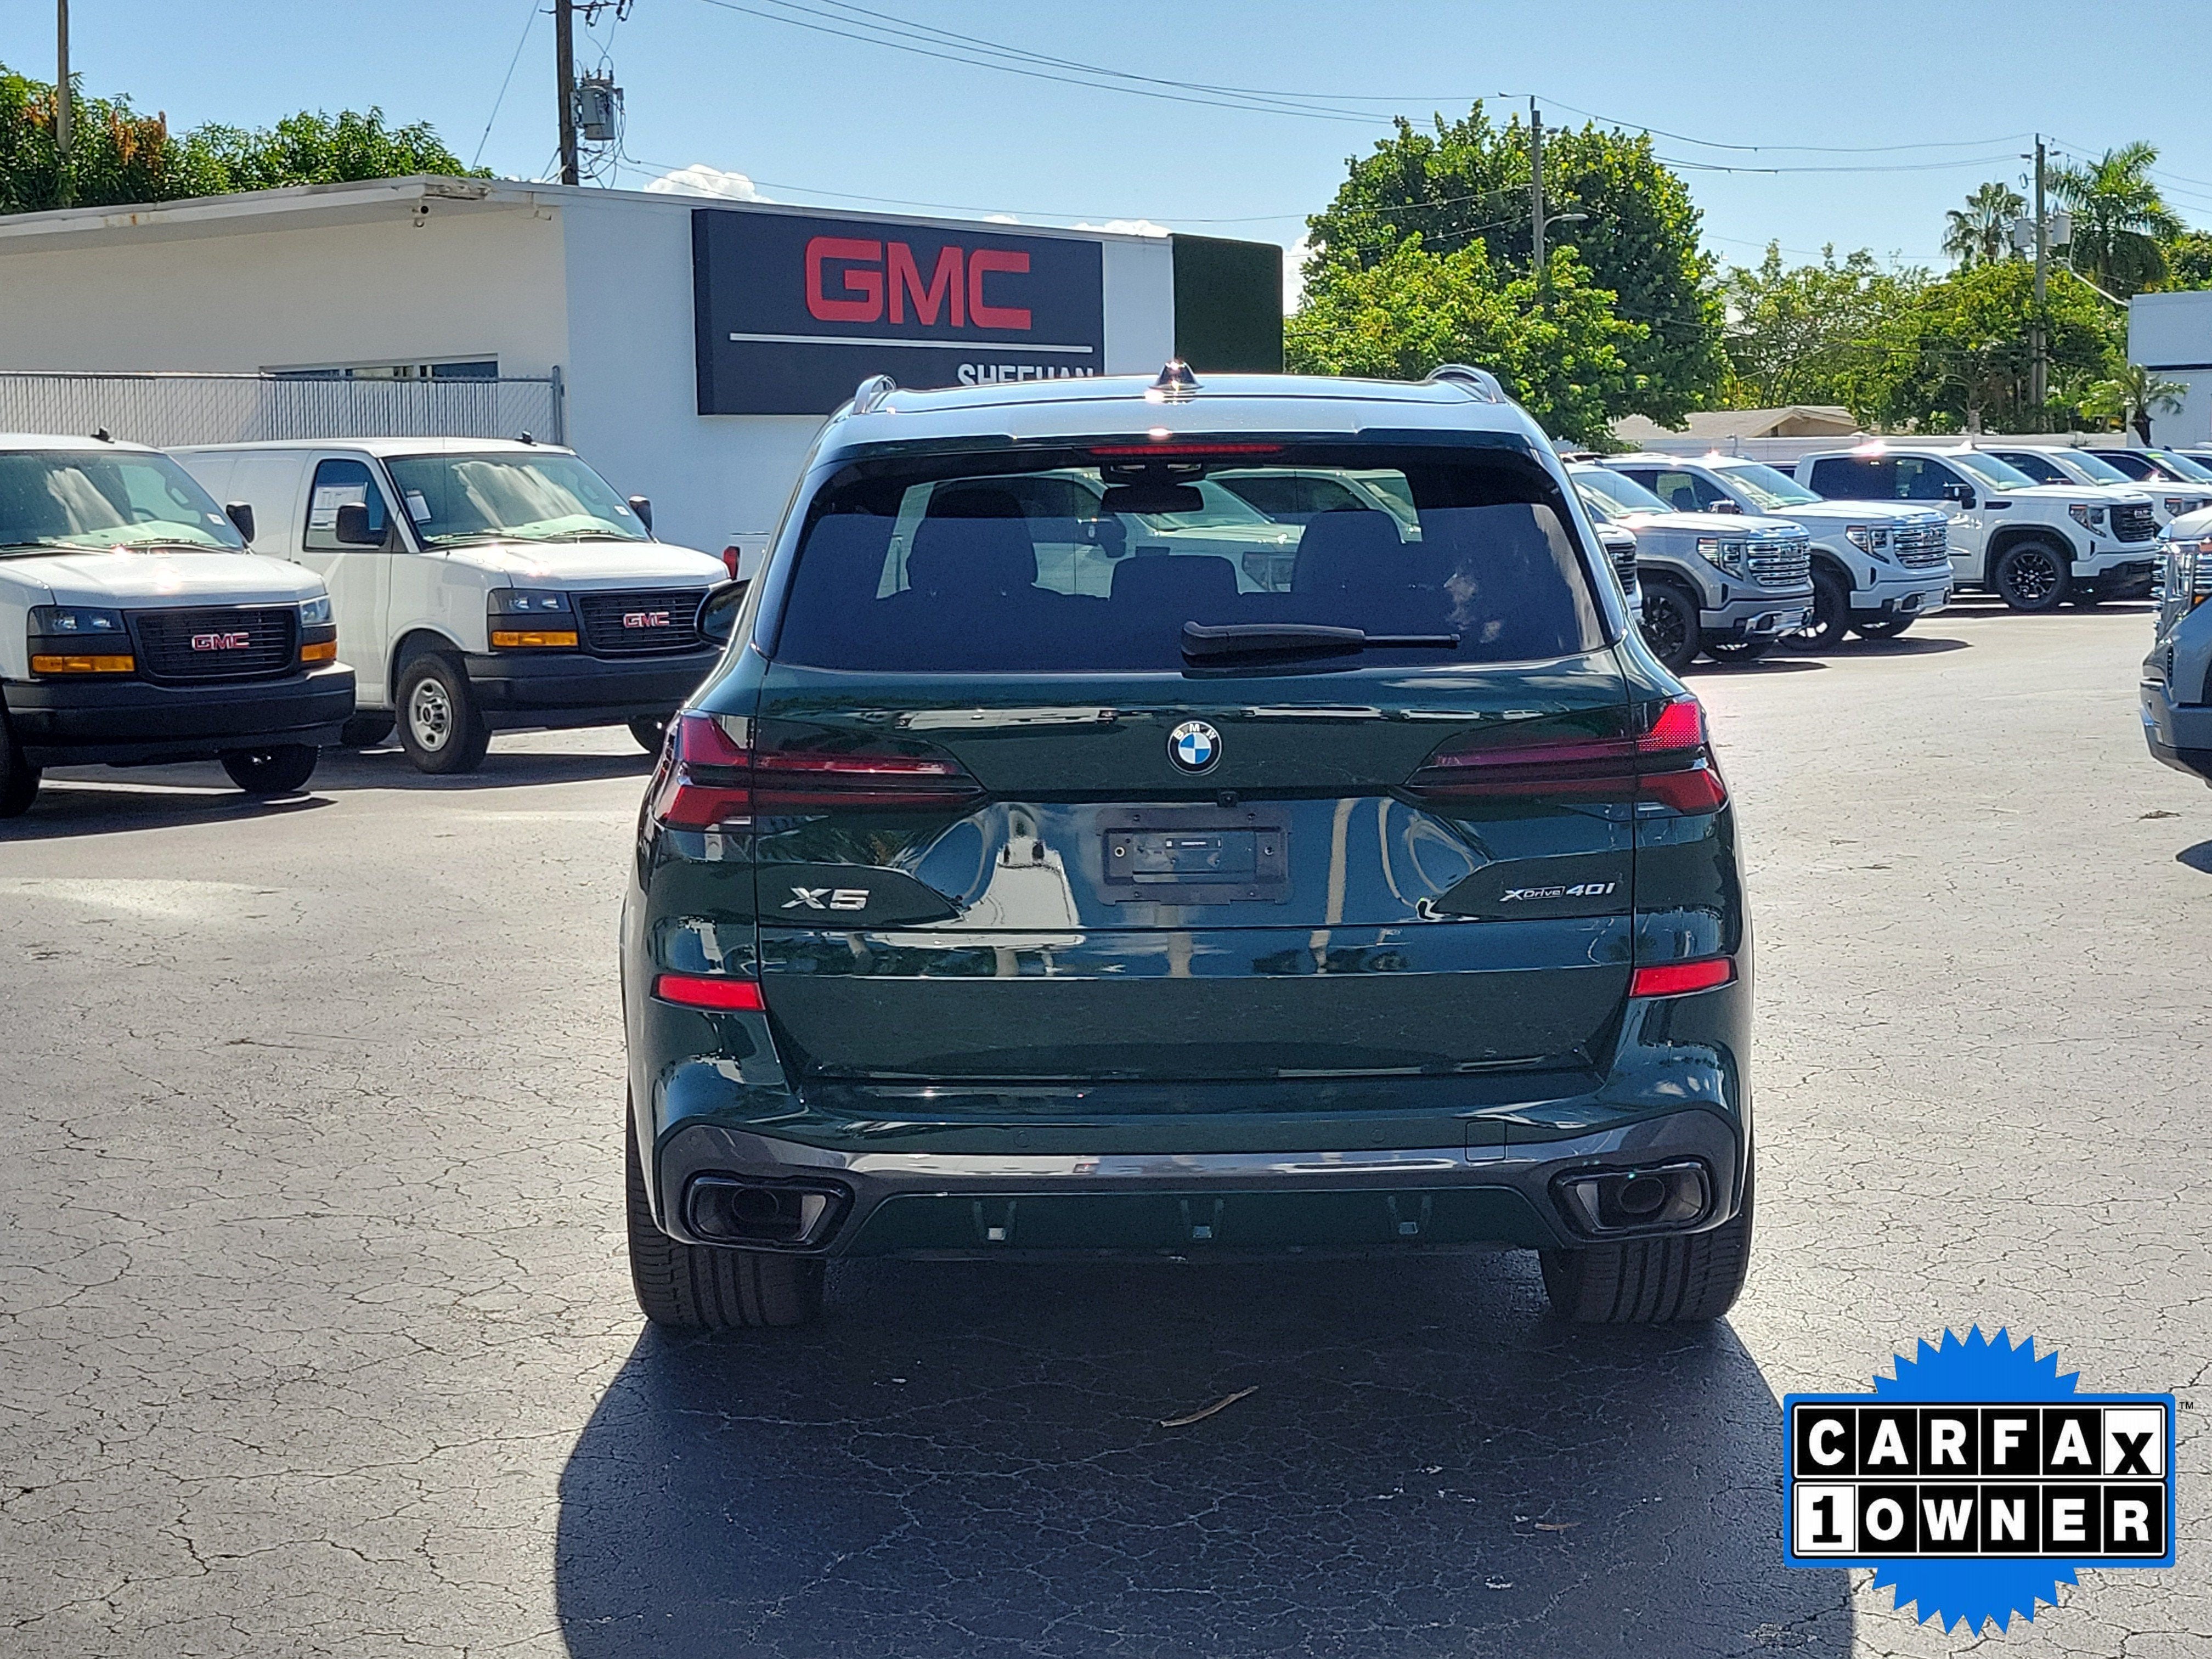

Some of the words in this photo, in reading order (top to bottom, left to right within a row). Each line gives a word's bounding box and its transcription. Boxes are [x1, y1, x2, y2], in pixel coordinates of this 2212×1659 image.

[806, 236, 1031, 330] GMC
[623, 611, 670, 628] GMC
[191, 632, 250, 651] GMC
[1173, 724, 1217, 740] BMW
[781, 888, 870, 910] X5
